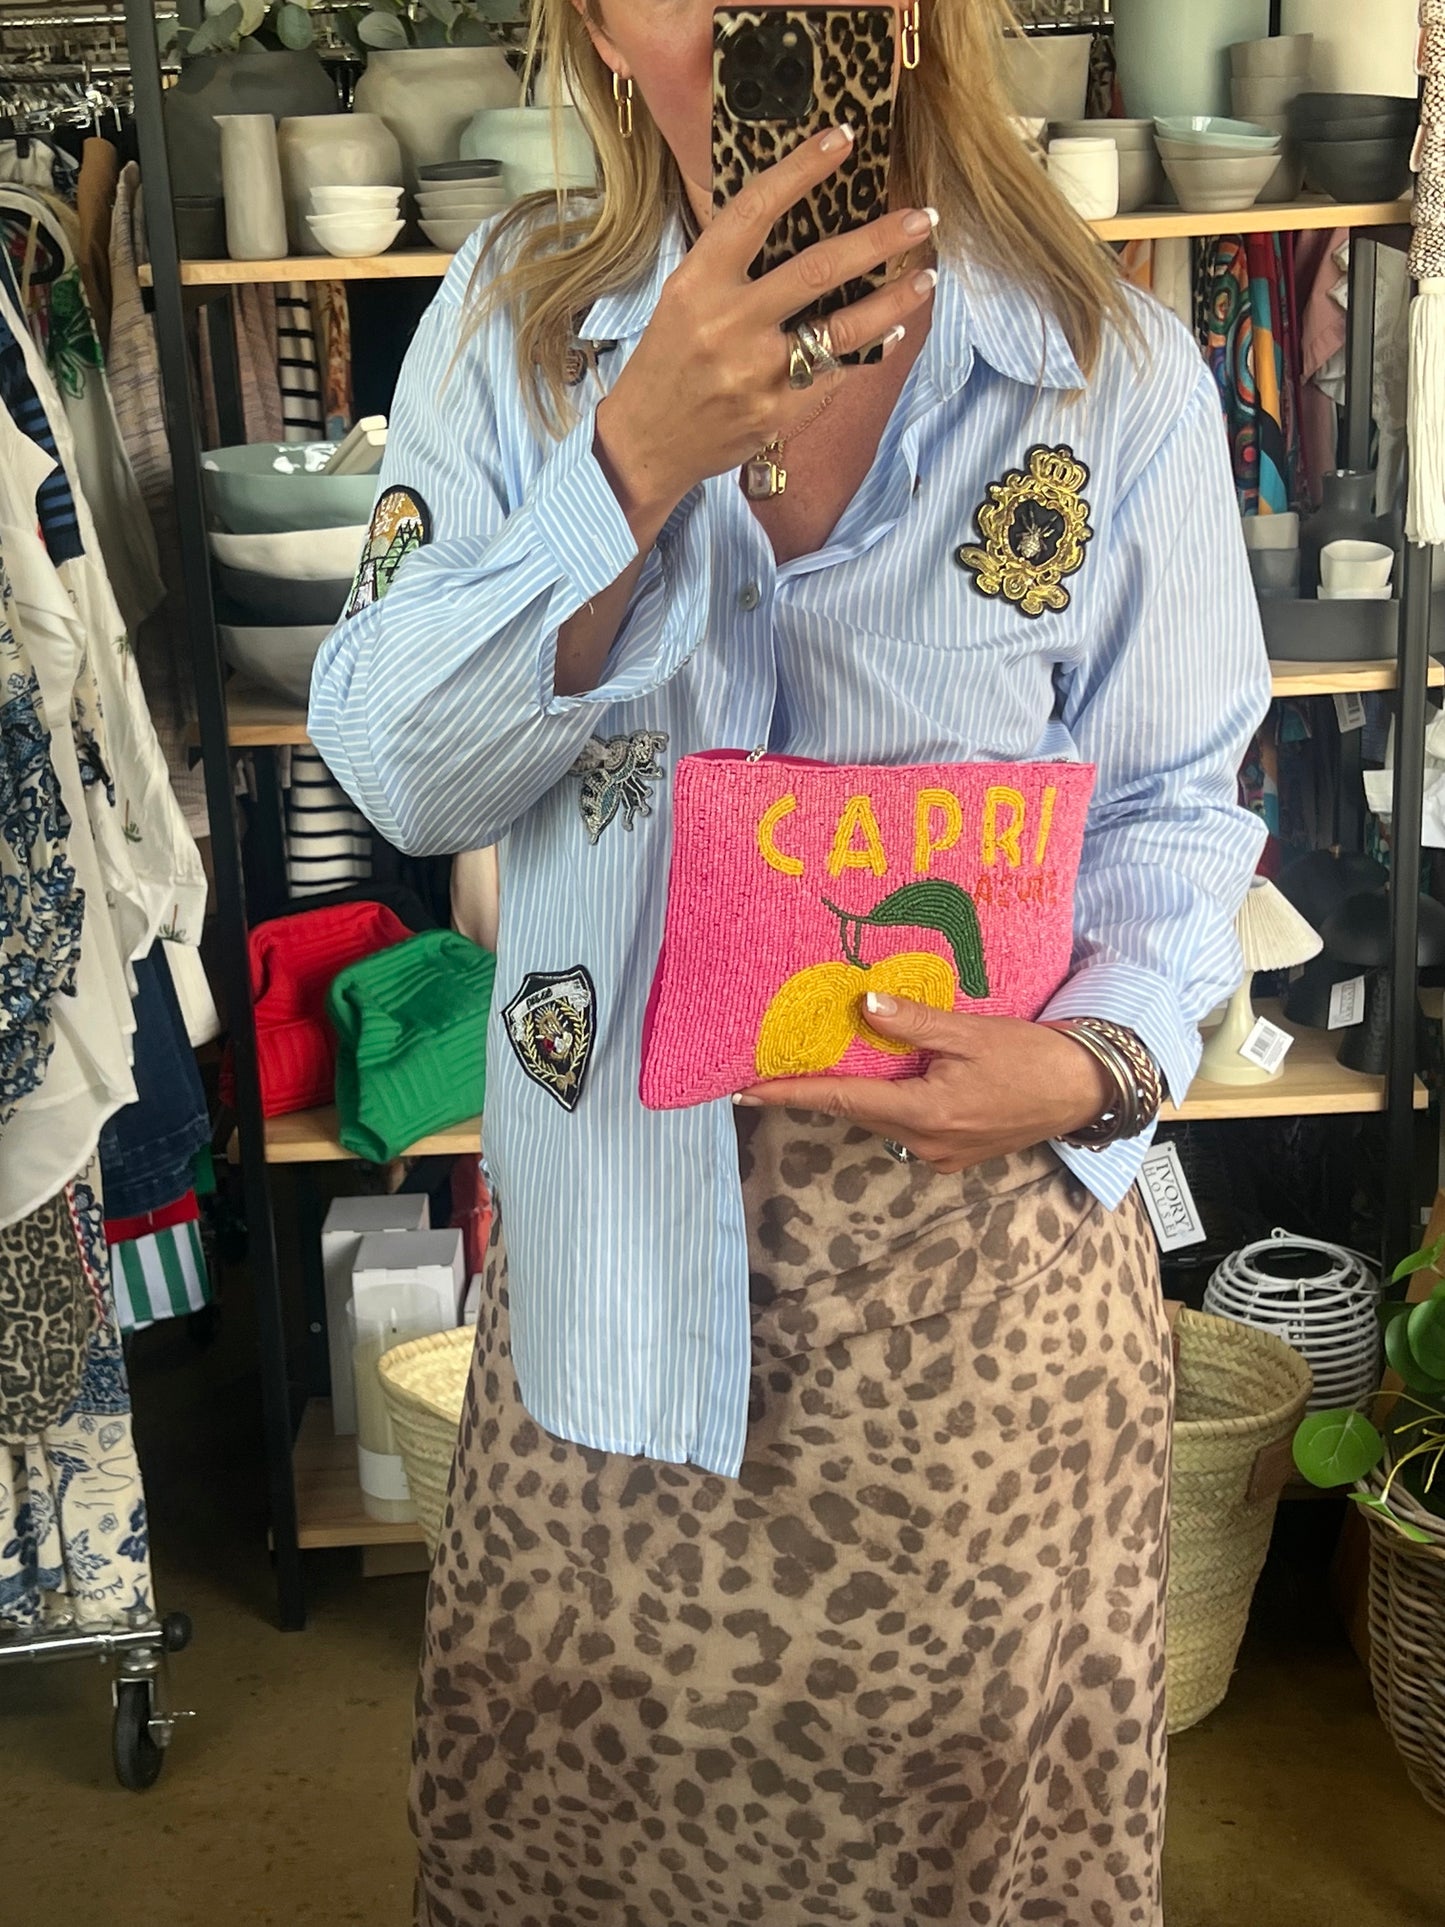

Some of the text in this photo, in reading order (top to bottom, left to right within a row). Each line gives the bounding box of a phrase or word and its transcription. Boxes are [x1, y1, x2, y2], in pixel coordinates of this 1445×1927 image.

[757, 786, 1057, 877] CAPRI
[1145, 1167, 1175, 1231] HOUSE
[1156, 1163, 1190, 1228] IVORY
